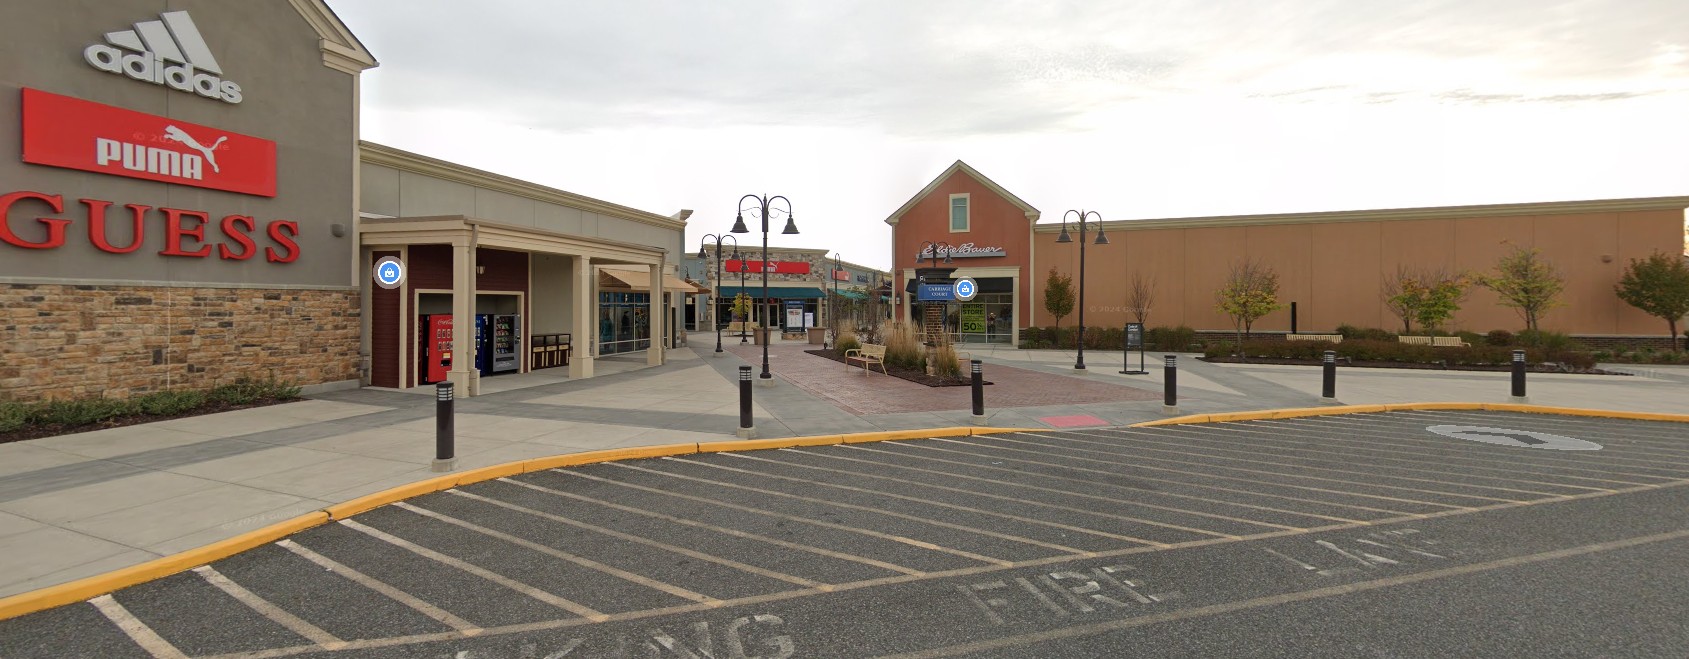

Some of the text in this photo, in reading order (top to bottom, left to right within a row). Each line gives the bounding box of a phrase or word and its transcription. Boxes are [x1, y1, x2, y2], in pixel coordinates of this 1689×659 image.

[84, 44, 243, 104] adidas
[96, 137, 203, 180] PUMA
[0, 190, 301, 263] GUESS
[957, 242, 1003, 254] Bauer
[956, 563, 1184, 626] FIRE
